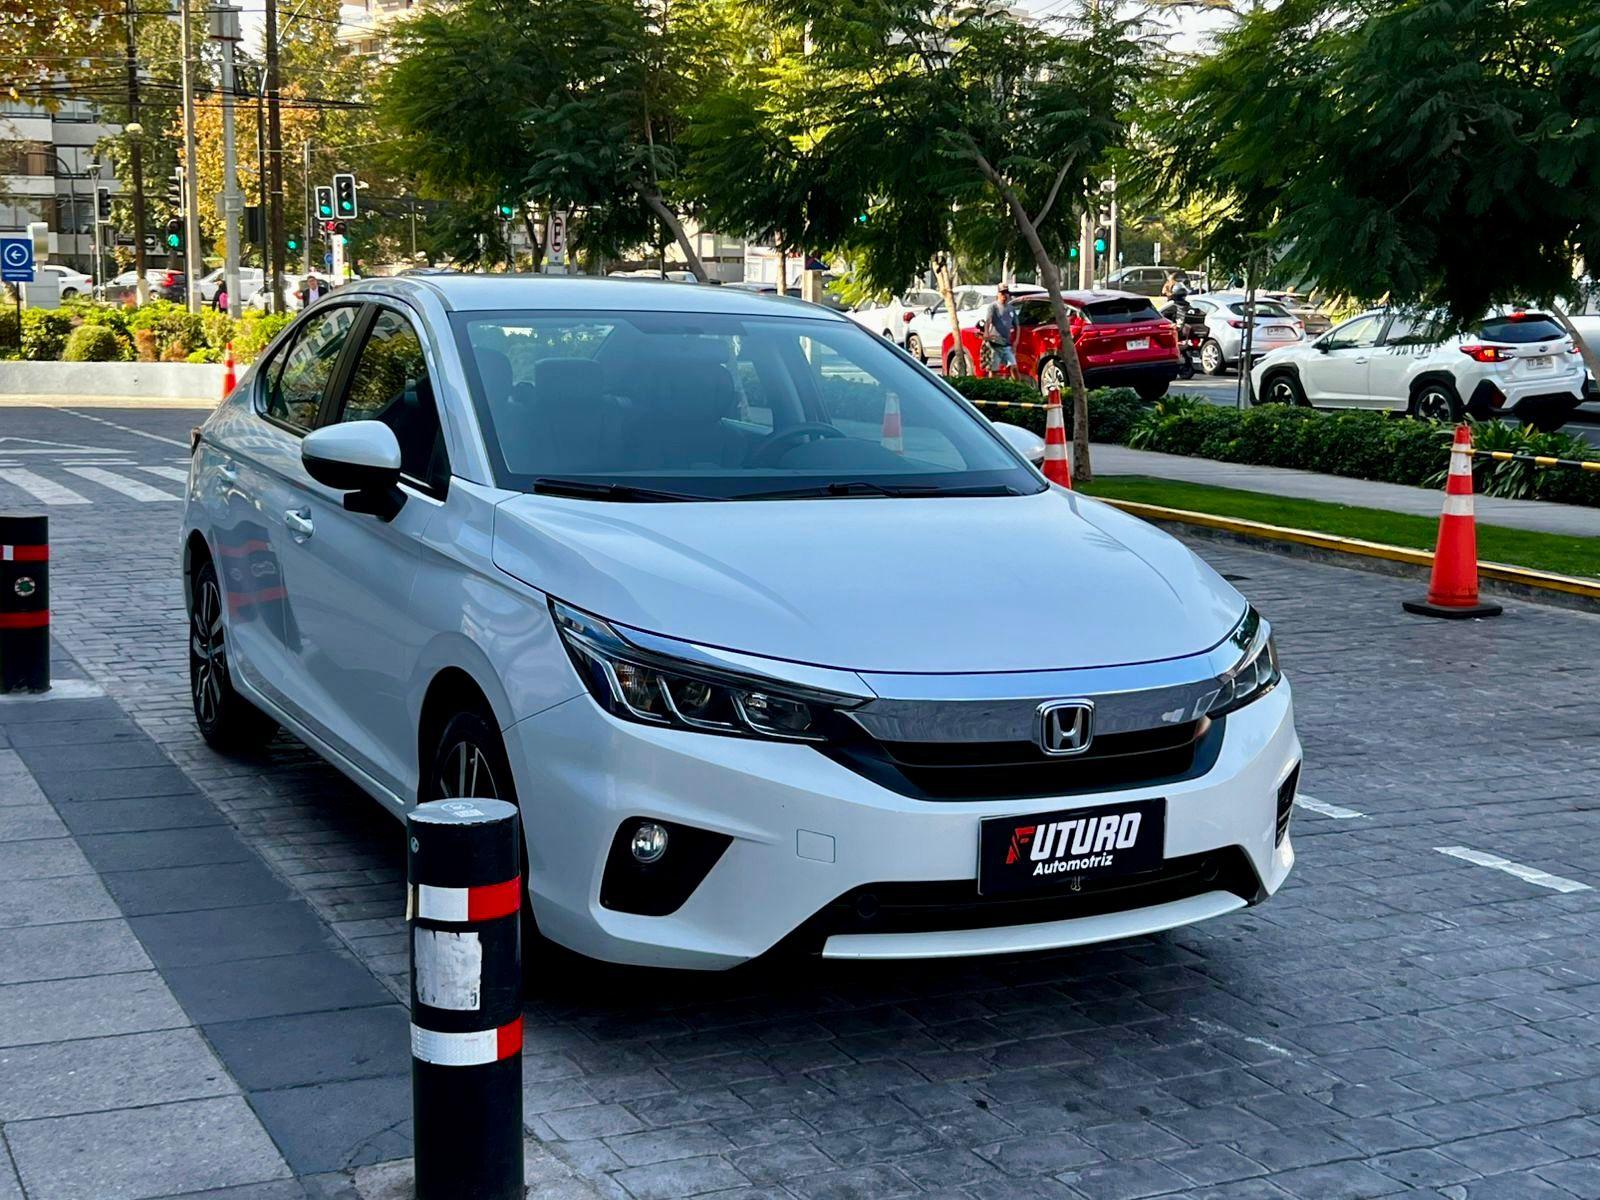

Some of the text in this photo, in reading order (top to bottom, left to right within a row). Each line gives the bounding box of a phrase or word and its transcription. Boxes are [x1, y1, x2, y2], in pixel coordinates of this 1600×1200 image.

[553, 222, 562, 246] E
[1006, 812, 1142, 864] FUTURO
[1032, 851, 1114, 876] Automotriz
